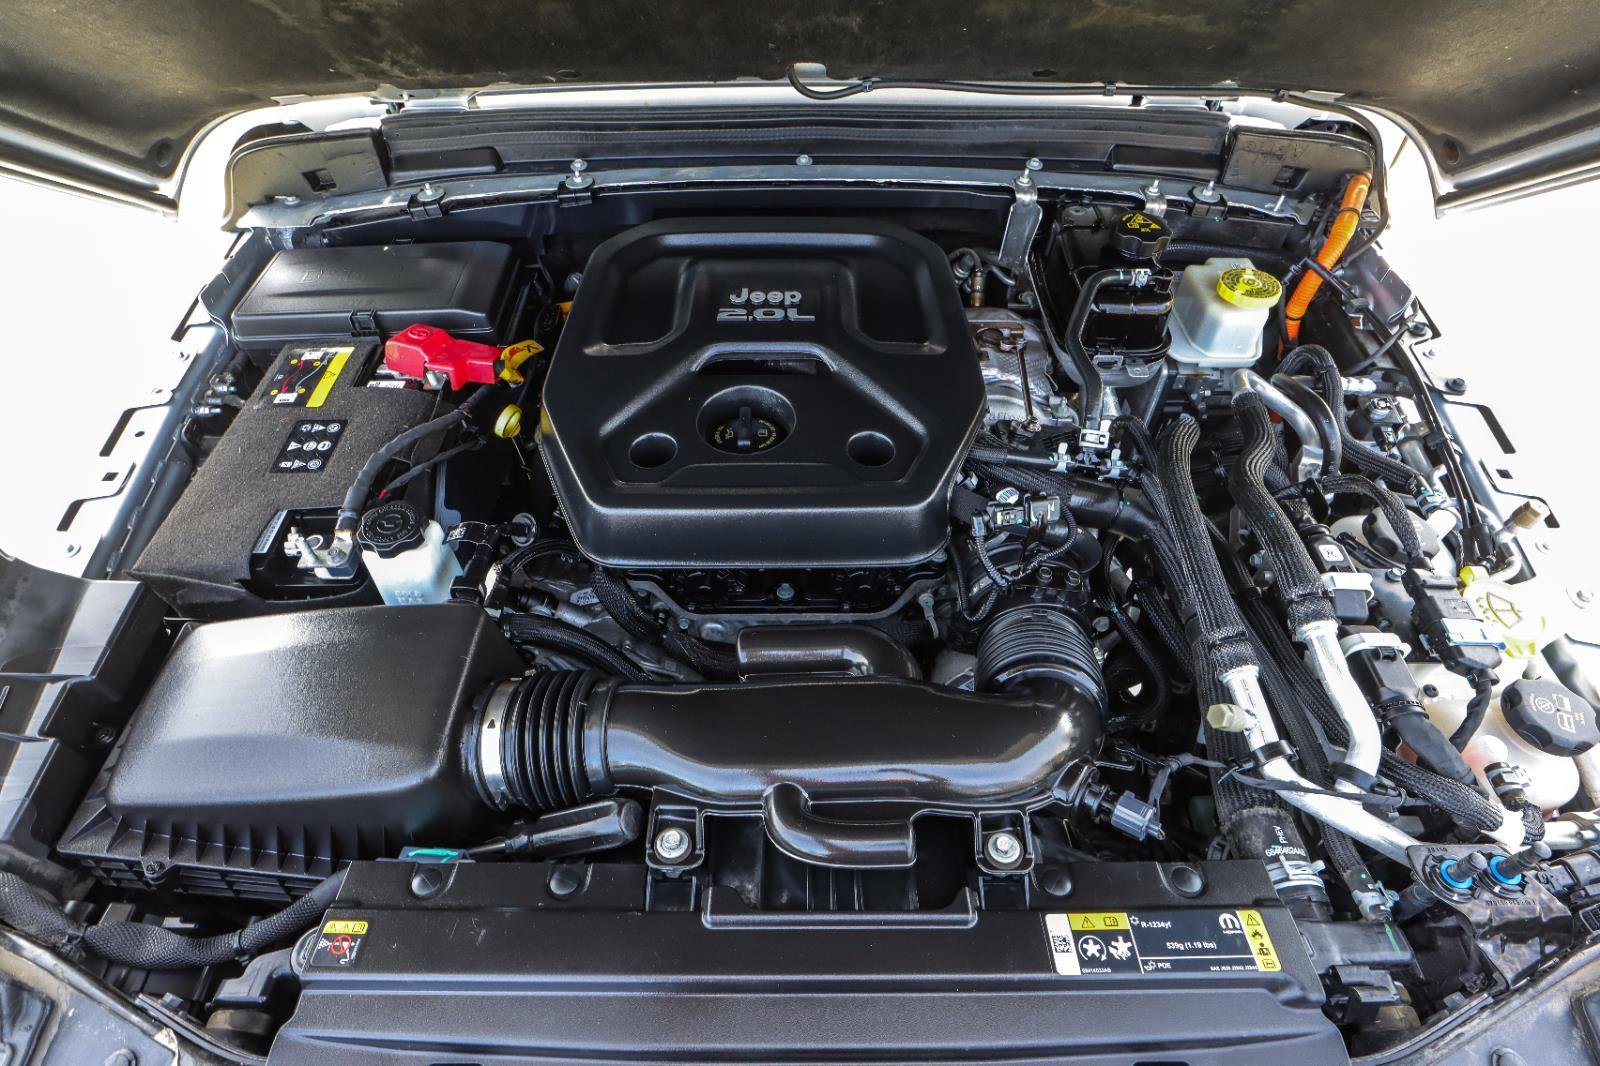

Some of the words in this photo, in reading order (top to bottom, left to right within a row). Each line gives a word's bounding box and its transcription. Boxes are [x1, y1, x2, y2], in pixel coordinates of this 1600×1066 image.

[729, 288, 802, 305] Jeep
[717, 308, 816, 322] 2.0L
[1272, 825, 1288, 844] PHEV
[1140, 920, 1172, 929] R-1234yf
[1166, 941, 1184, 950] 539g
